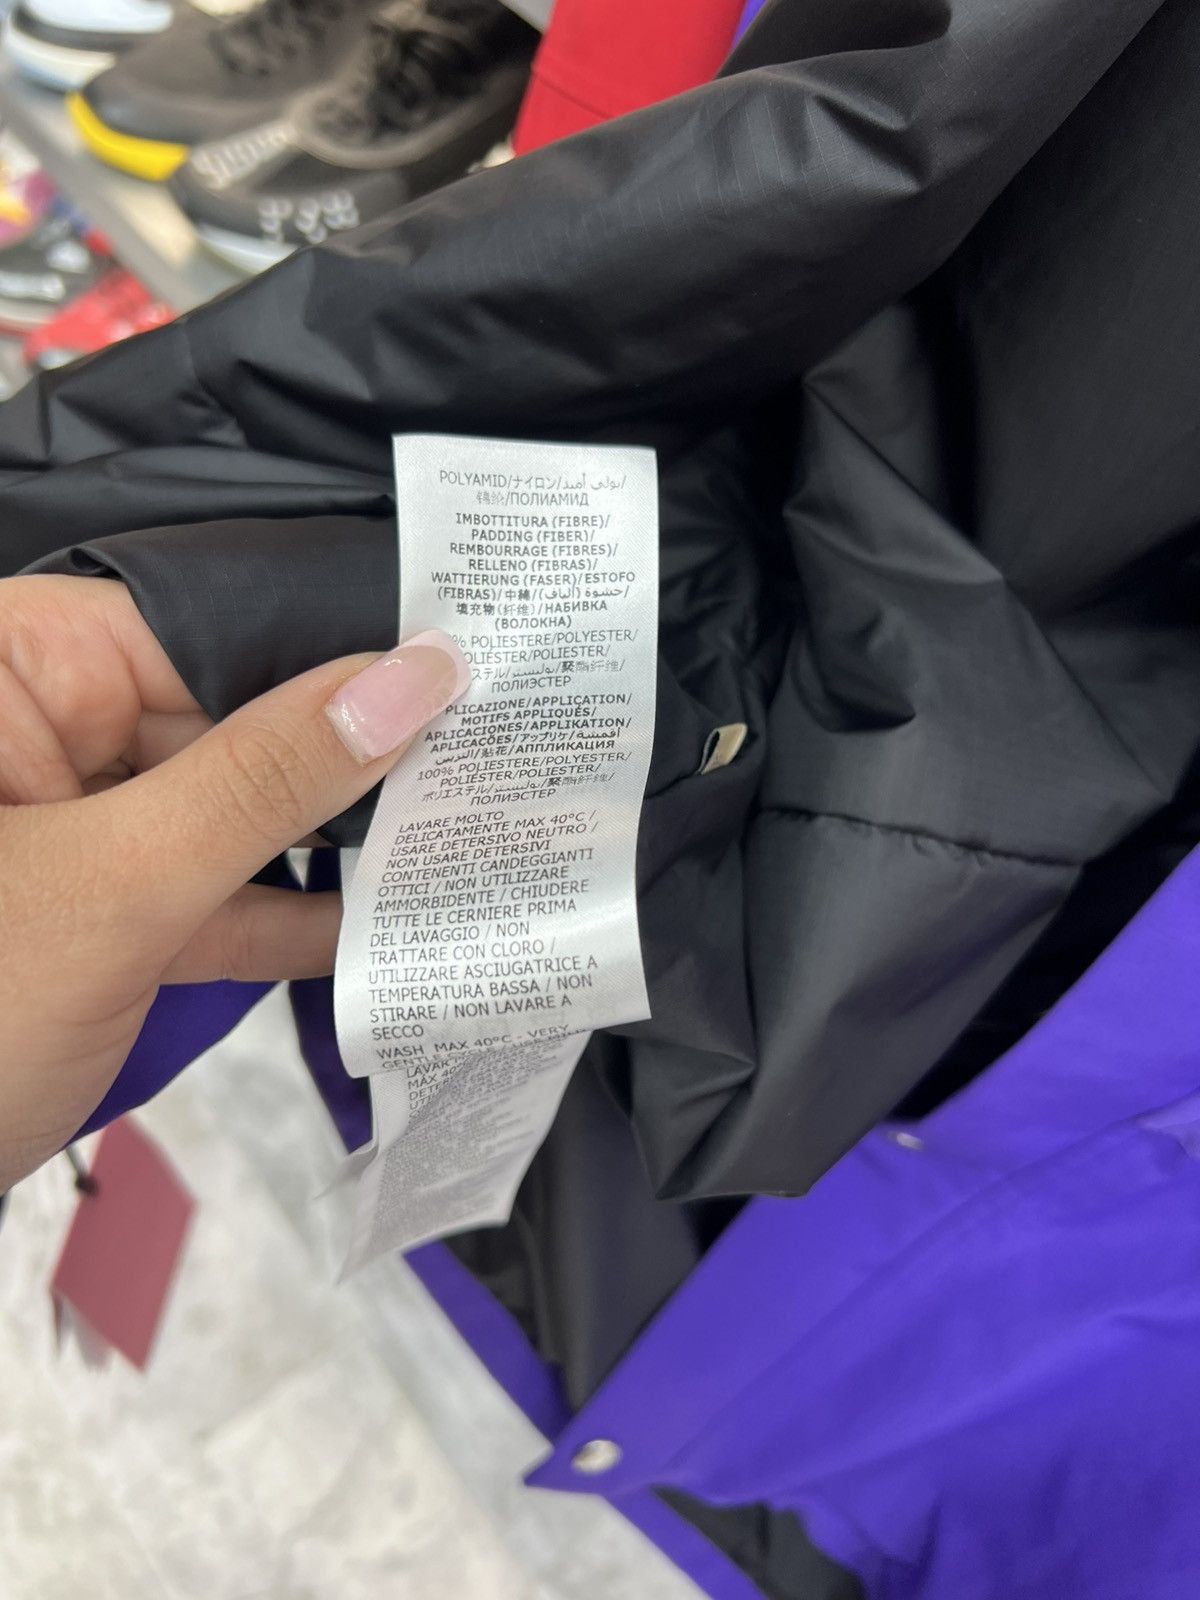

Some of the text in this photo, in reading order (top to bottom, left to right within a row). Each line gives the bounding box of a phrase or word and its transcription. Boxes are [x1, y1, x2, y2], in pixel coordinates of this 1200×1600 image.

[456, 513, 610, 528] IMBOTTITURA (FIBRE)/
[471, 529, 595, 543] PADDING (FIBER)/
[450, 543, 618, 558] REMBOURRAGE (FIBRES)/
[469, 558, 598, 572] RELLENO (FIBRAS)/
[431, 571, 635, 587] WATTIERUNG (FASER)/ESTOFO
[495, 615, 572, 631] (ВОЛОКНА)
[471, 629, 638, 648] POLIESTERE/POLYESTER/
[463, 645, 610, 665] OLIESTER/POLIESTER/
[491, 676, 572, 694] ПОЛИЭСТЕР
[446, 693, 632, 715] PLICAZIONE/APPLICATION/
[461, 704, 597, 726] MOTIFS APPLIQUÉS/
[425, 717, 632, 742] APLICACIONES/APPLIKATION/
[417, 752, 632, 781] 100% POLIESTERE/POLYESTER/
[440, 763, 601, 788] POLIESTER/POLIESTER/
[470, 788, 556, 806] ПОЛИЭСТЕР
[394, 821, 510, 845] DELICATAMENTE
[515, 817, 546, 829] MAX
[399, 811, 504, 833] LAVARE MOLTO
[390, 842, 437, 857] USARE
[441, 831, 521, 851] DETERSIVO
[526, 823, 587, 840] NEUTRO
[382, 848, 594, 883] CONTENENTI CANDEGGIANTI
[386, 839, 552, 869] NON USARE DETERSIVI
[378, 882, 430, 897] OTTICI
[444, 876, 477, 891] NON
[482, 865, 570, 887] UTILIZZARE
[374, 890, 495, 913] AMMORBIDENTE
[511, 879, 590, 901] CHIUDERE
[372, 898, 577, 929] TUTTE LE CERNIERE PRIMA
[370, 932, 397, 947] DEL
[402, 925, 480, 945] LAVAGGIO
[496, 921, 530, 937] NON
[370, 946, 448, 965] TRATTARE
[453, 944, 486, 960] CON
[491, 938, 544, 957] CLORO
[368, 954, 598, 984] UTILIZZARE ASCIUGATRICE A
[368, 983, 484, 1003] TEMPERATURA
[489, 978, 540, 997] BASSA
[557, 973, 592, 990] NON
[370, 1005, 437, 1023] STIRARE
[454, 1001, 489, 1018] NON
[495, 995, 557, 1014] LAVARE
[561, 993, 572, 1007] A
[372, 1024, 424, 1040] SECCO
[376, 1044, 424, 1059] WASH
[433, 1040, 469, 1053] MAX
[527, 1024, 569, 1038] VERY
